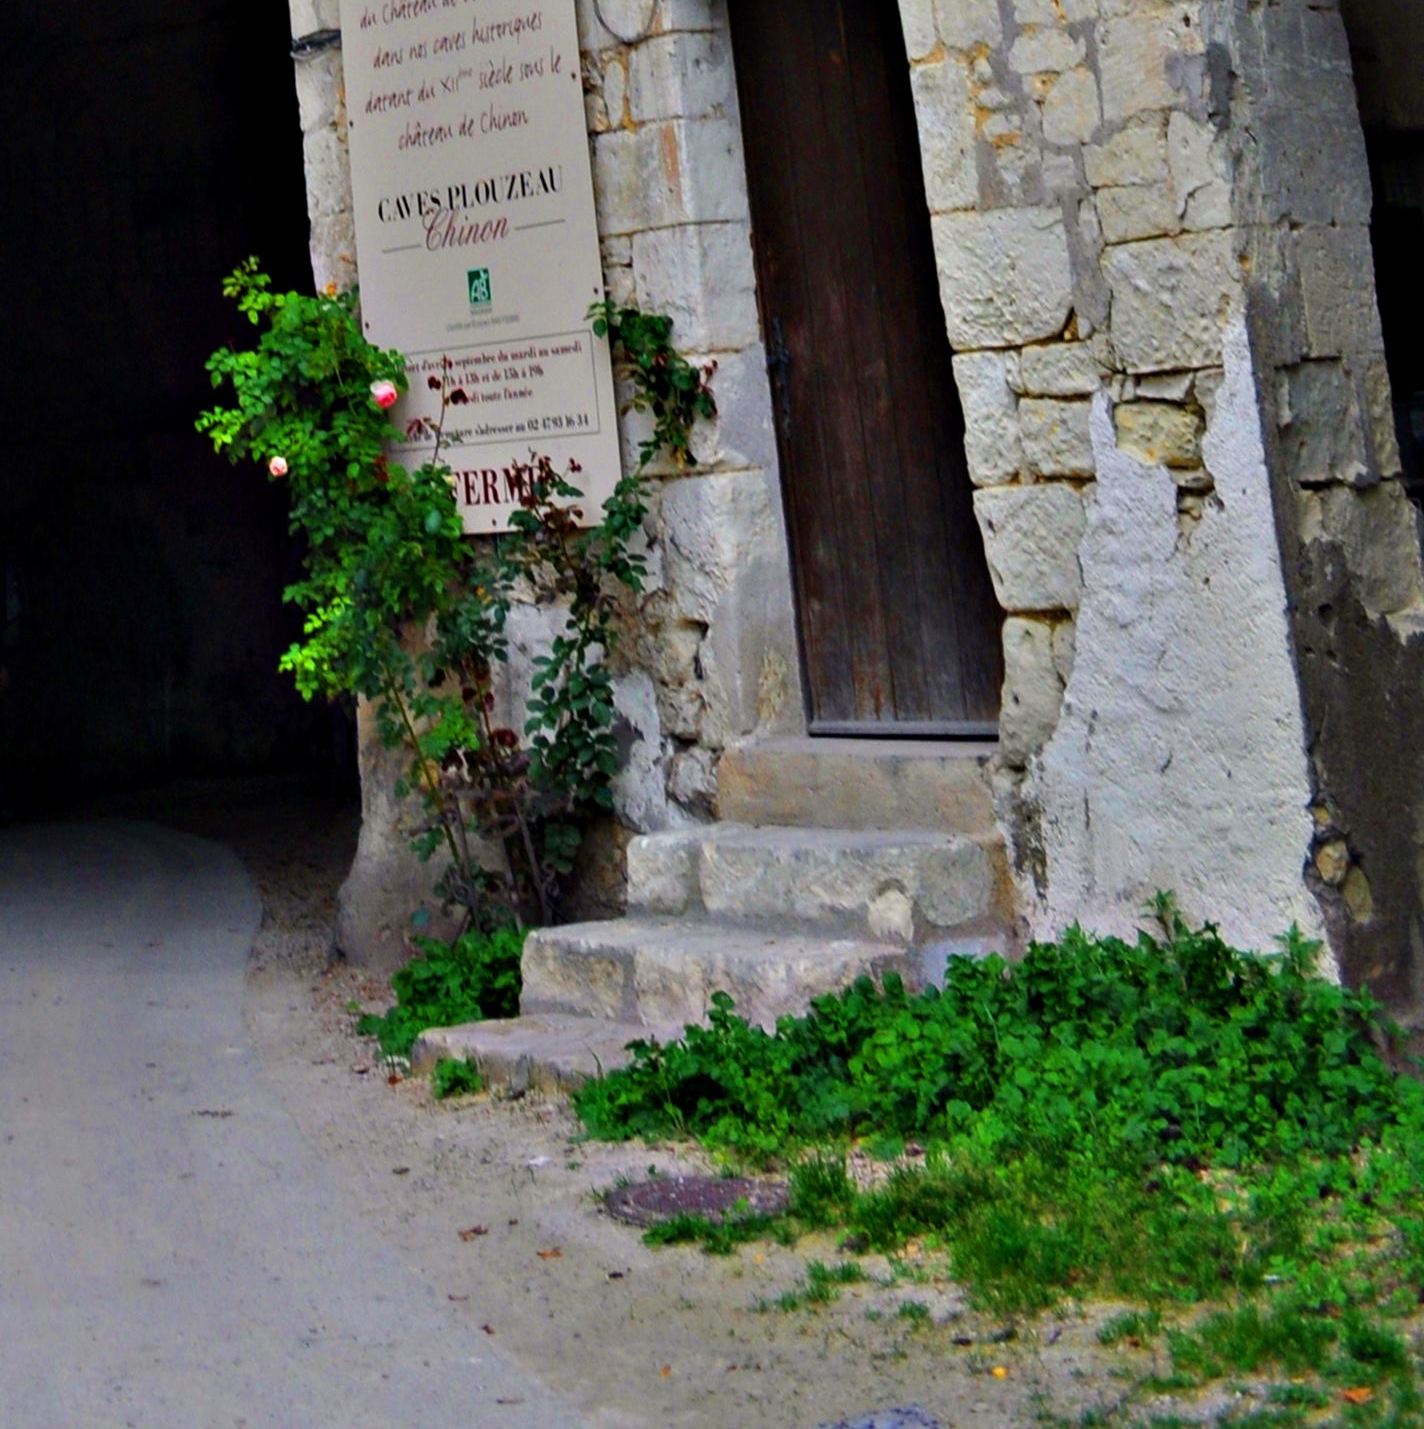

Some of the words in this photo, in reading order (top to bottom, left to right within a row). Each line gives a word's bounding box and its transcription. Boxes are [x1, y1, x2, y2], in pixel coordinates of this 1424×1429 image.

[359, 7, 377, 30] du
[373, 44, 404, 69] dans
[409, 41, 427, 60] nos
[433, 30, 467, 55] caves
[472, 11, 543, 46] historiques
[365, 87, 413, 115] datant
[417, 80, 436, 102] du
[479, 58, 513, 90] siècle
[519, 59, 544, 82] sous
[550, 45, 562, 76] le
[398, 118, 453, 151] château
[459, 113, 475, 138] de
[480, 103, 529, 134] Chinon
[378, 190, 442, 223] CAVES
[447, 165, 564, 212] PLOUZEAU
[423, 206, 510, 252] Chinon
